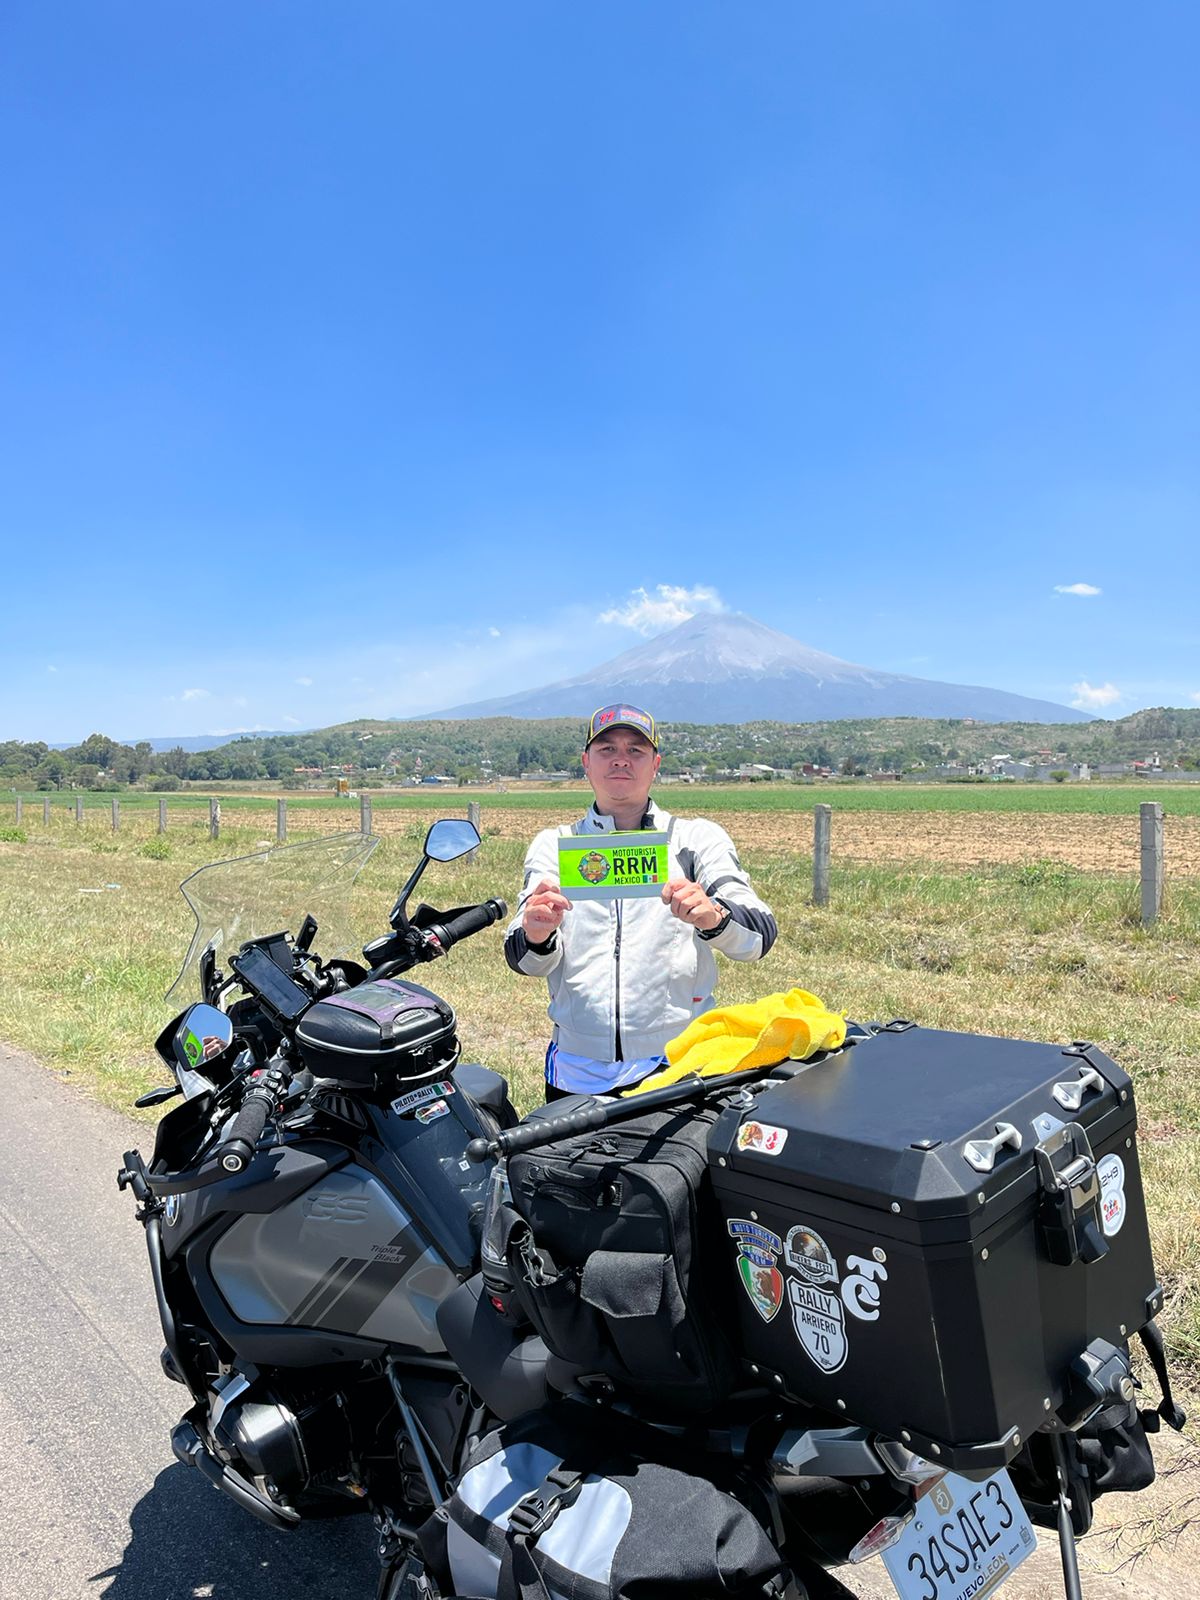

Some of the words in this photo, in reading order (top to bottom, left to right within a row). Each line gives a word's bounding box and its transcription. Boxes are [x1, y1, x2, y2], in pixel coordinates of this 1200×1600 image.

[612, 847, 656, 857] MOTOTURISTA
[613, 856, 657, 875] RRM
[614, 876, 640, 884] MEXICO
[370, 1245, 397, 1254] Triple
[374, 1254, 400, 1262] Black
[798, 1287, 831, 1314] RALLY
[802, 1311, 836, 1335] ARRIERO
[812, 1331, 830, 1355] 70
[908, 1480, 1013, 1600] 34SAE3
